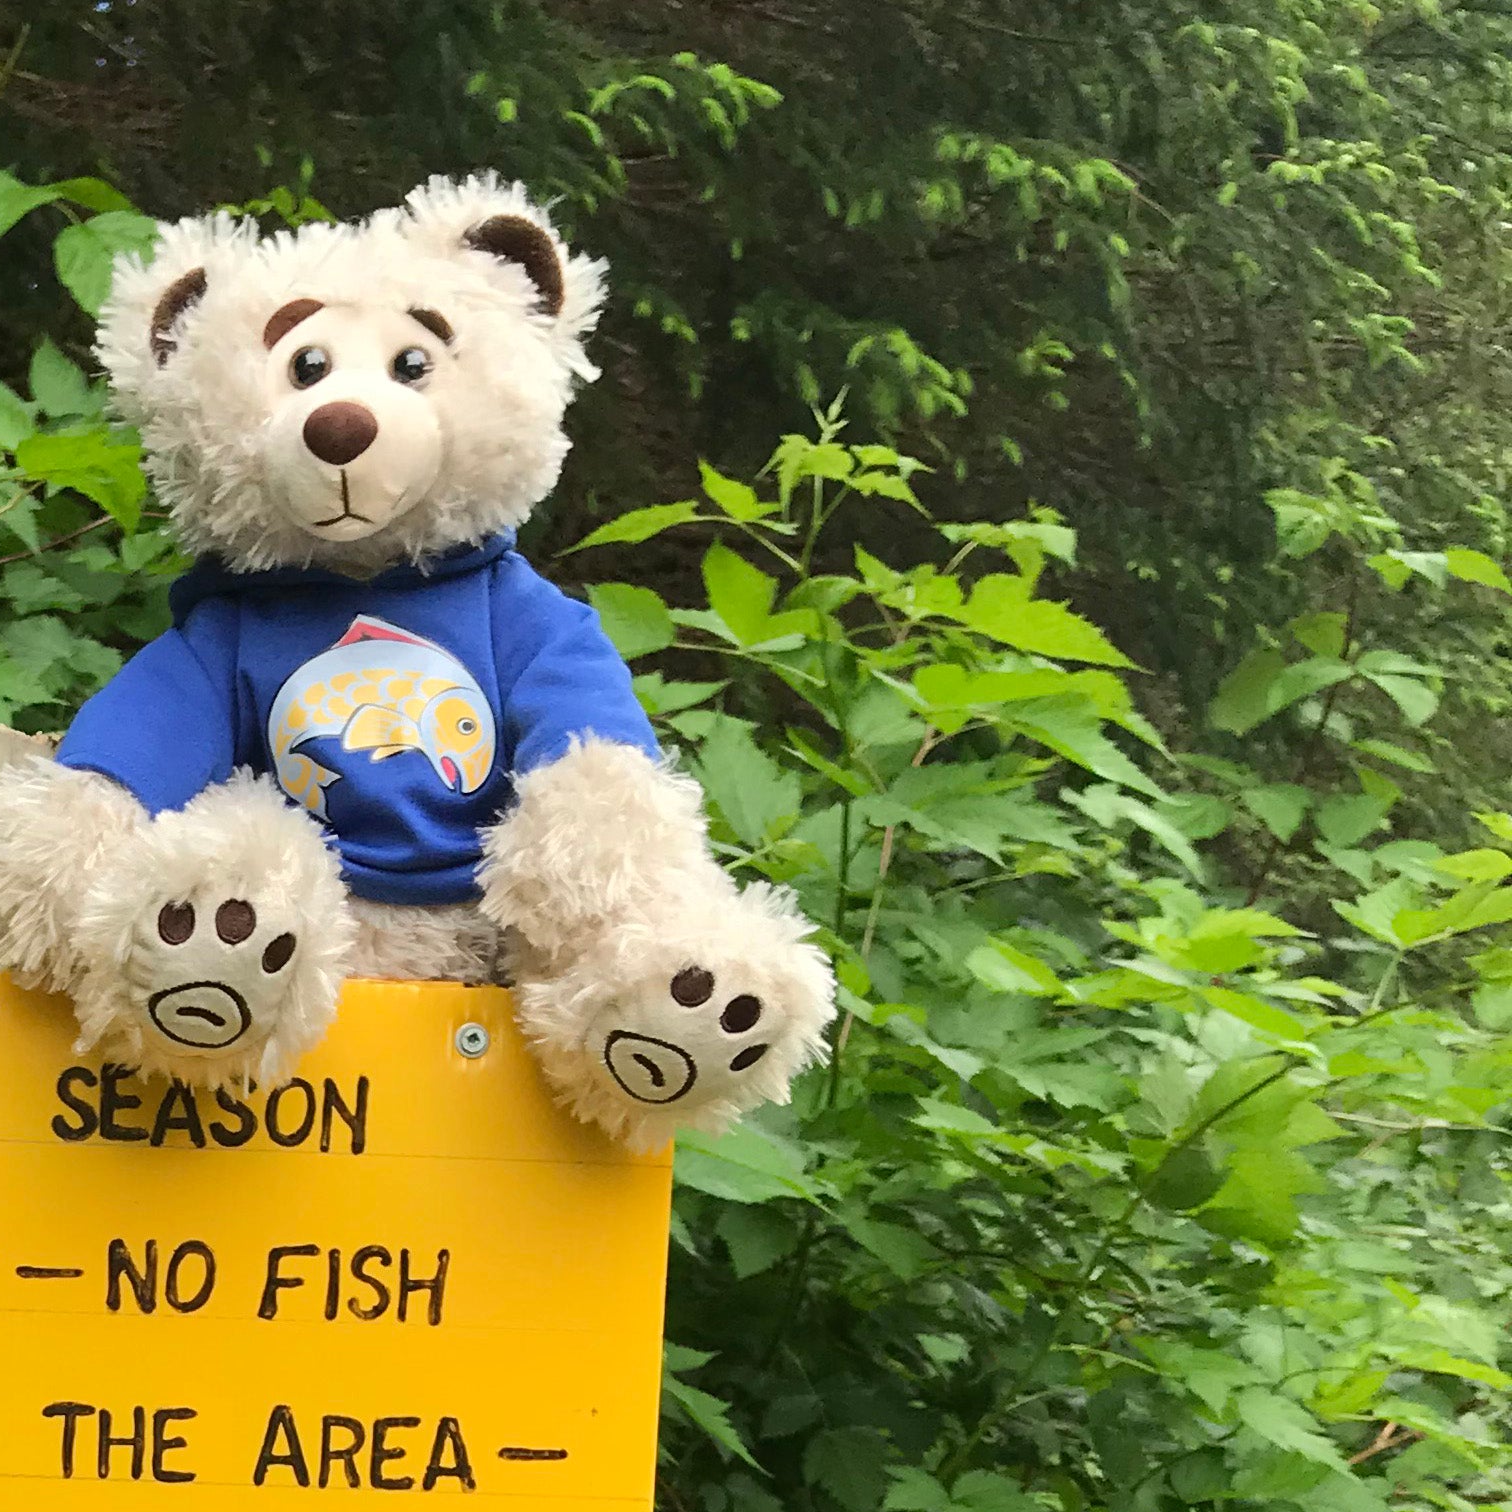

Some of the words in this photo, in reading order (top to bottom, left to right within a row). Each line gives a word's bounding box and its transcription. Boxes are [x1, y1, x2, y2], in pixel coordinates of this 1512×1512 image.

[51, 1063, 369, 1155] SEASON
[257, 1244, 449, 1326] FISH
[42, 1402, 197, 1483] THE
